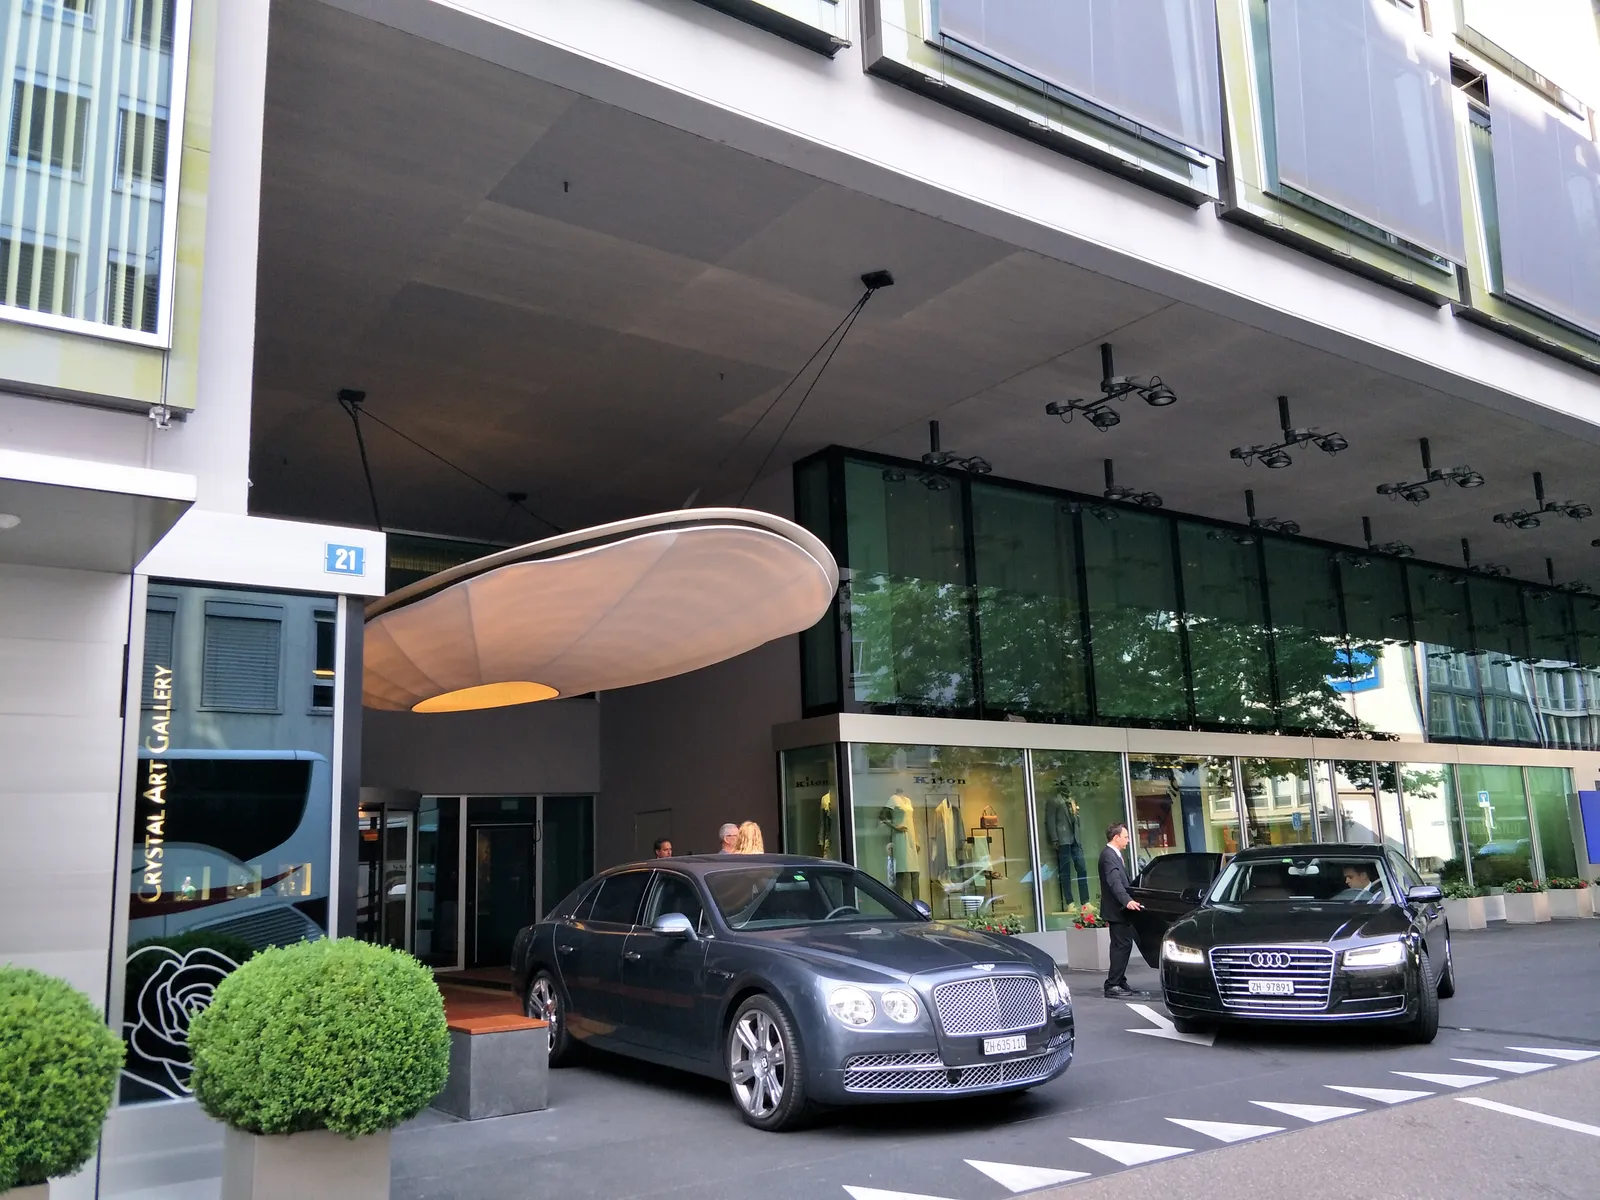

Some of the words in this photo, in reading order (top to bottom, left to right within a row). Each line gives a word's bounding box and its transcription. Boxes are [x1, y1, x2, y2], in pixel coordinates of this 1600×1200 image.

[335, 548, 356, 571] 21
[145, 664, 173, 754] GALLERY
[142, 759, 168, 804] ART
[795, 776, 829, 788] Kiton
[912, 772, 967, 785] Kiton
[137, 809, 166, 903] CRYSTAL
[1251, 983, 1262, 992] ZH
[1266, 983, 1291, 992] 97891
[985, 1041, 995, 1053] ZH
